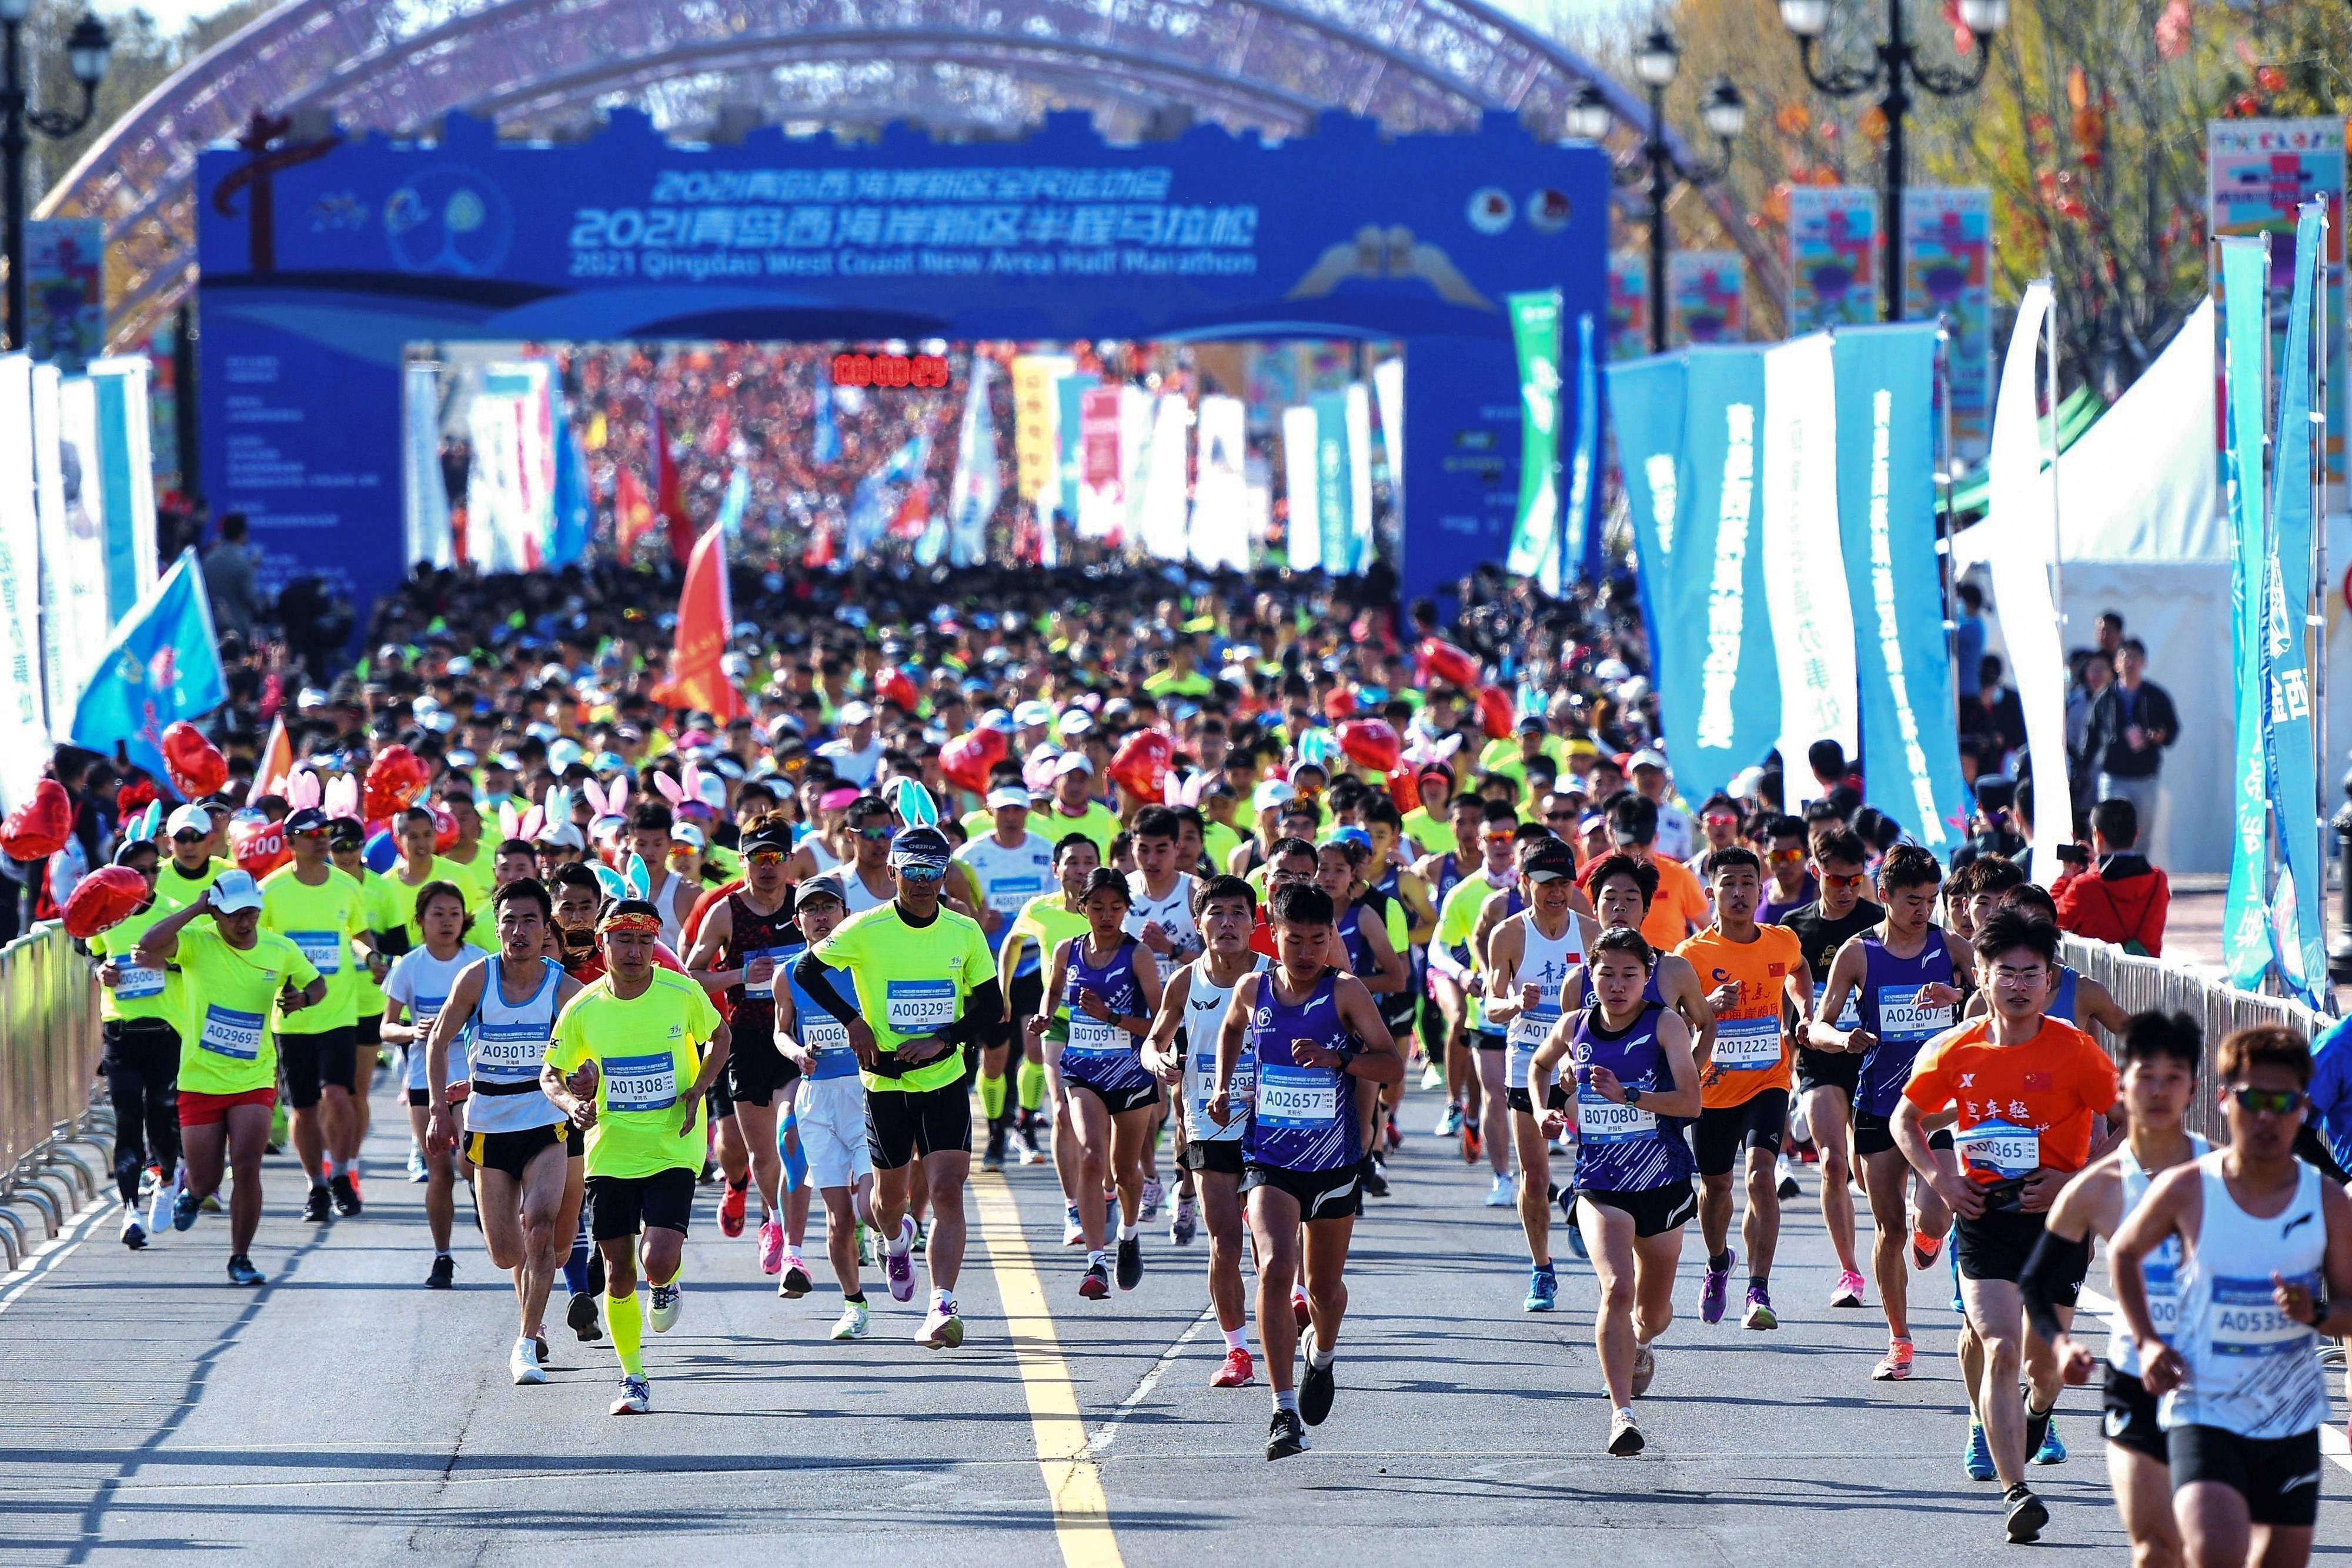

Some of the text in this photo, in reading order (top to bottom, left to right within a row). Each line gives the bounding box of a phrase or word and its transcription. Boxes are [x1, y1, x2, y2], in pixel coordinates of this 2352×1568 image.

[569, 205, 1258, 248] 2021青岛西海岸新区半程马拉松
[642, 249, 763, 280] Qingdao
[767, 252, 835, 275] West
[838, 251, 913, 275] Coast
[988, 250, 1055, 274] Area
[1062, 251, 1117, 275] Half
[1122, 250, 1257, 275] Marathon
[238, 835, 282, 860] 2:00
[892, 1002, 944, 1017] A00329
[1885, 1008, 1940, 1023] A02607
[206, 1024, 252, 1044] A02969
[1074, 1027, 1116, 1042] B07091
[482, 1045, 536, 1058] A03013
[1716, 1038, 1768, 1055] A01222
[610, 1078, 663, 1095] A01308
[1265, 1090, 1321, 1108] A02657
[1585, 1108, 1639, 1124] B07080
[1966, 1141, 2023, 1159] A00365
